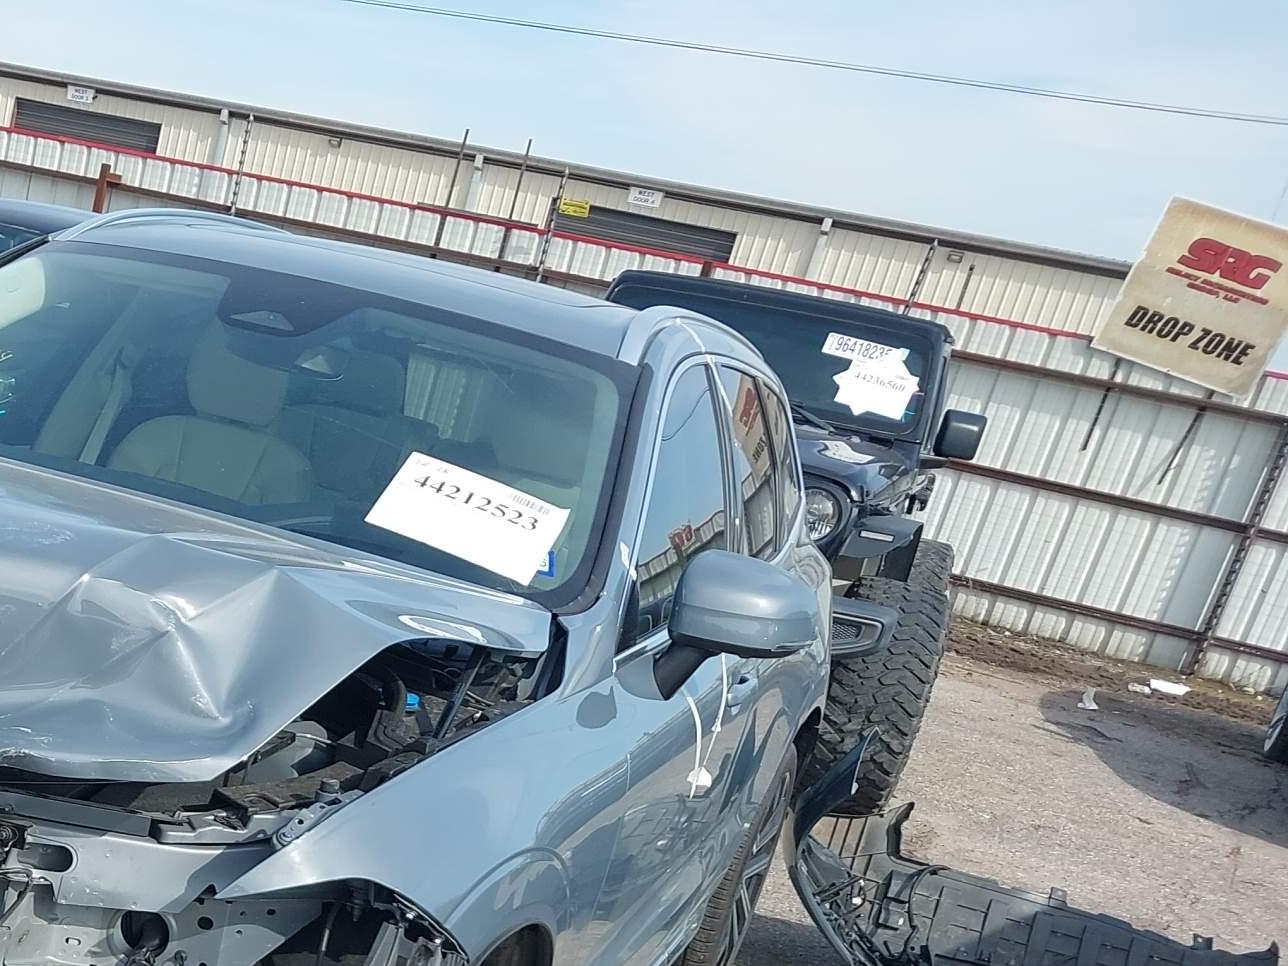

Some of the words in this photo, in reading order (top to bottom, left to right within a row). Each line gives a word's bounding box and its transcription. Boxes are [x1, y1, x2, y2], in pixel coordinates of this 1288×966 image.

[1177, 237, 1283, 290] SRG
[1124, 305, 1195, 343] DROP
[1188, 327, 1256, 365] ZONE
[413, 475, 540, 531] 44212523
